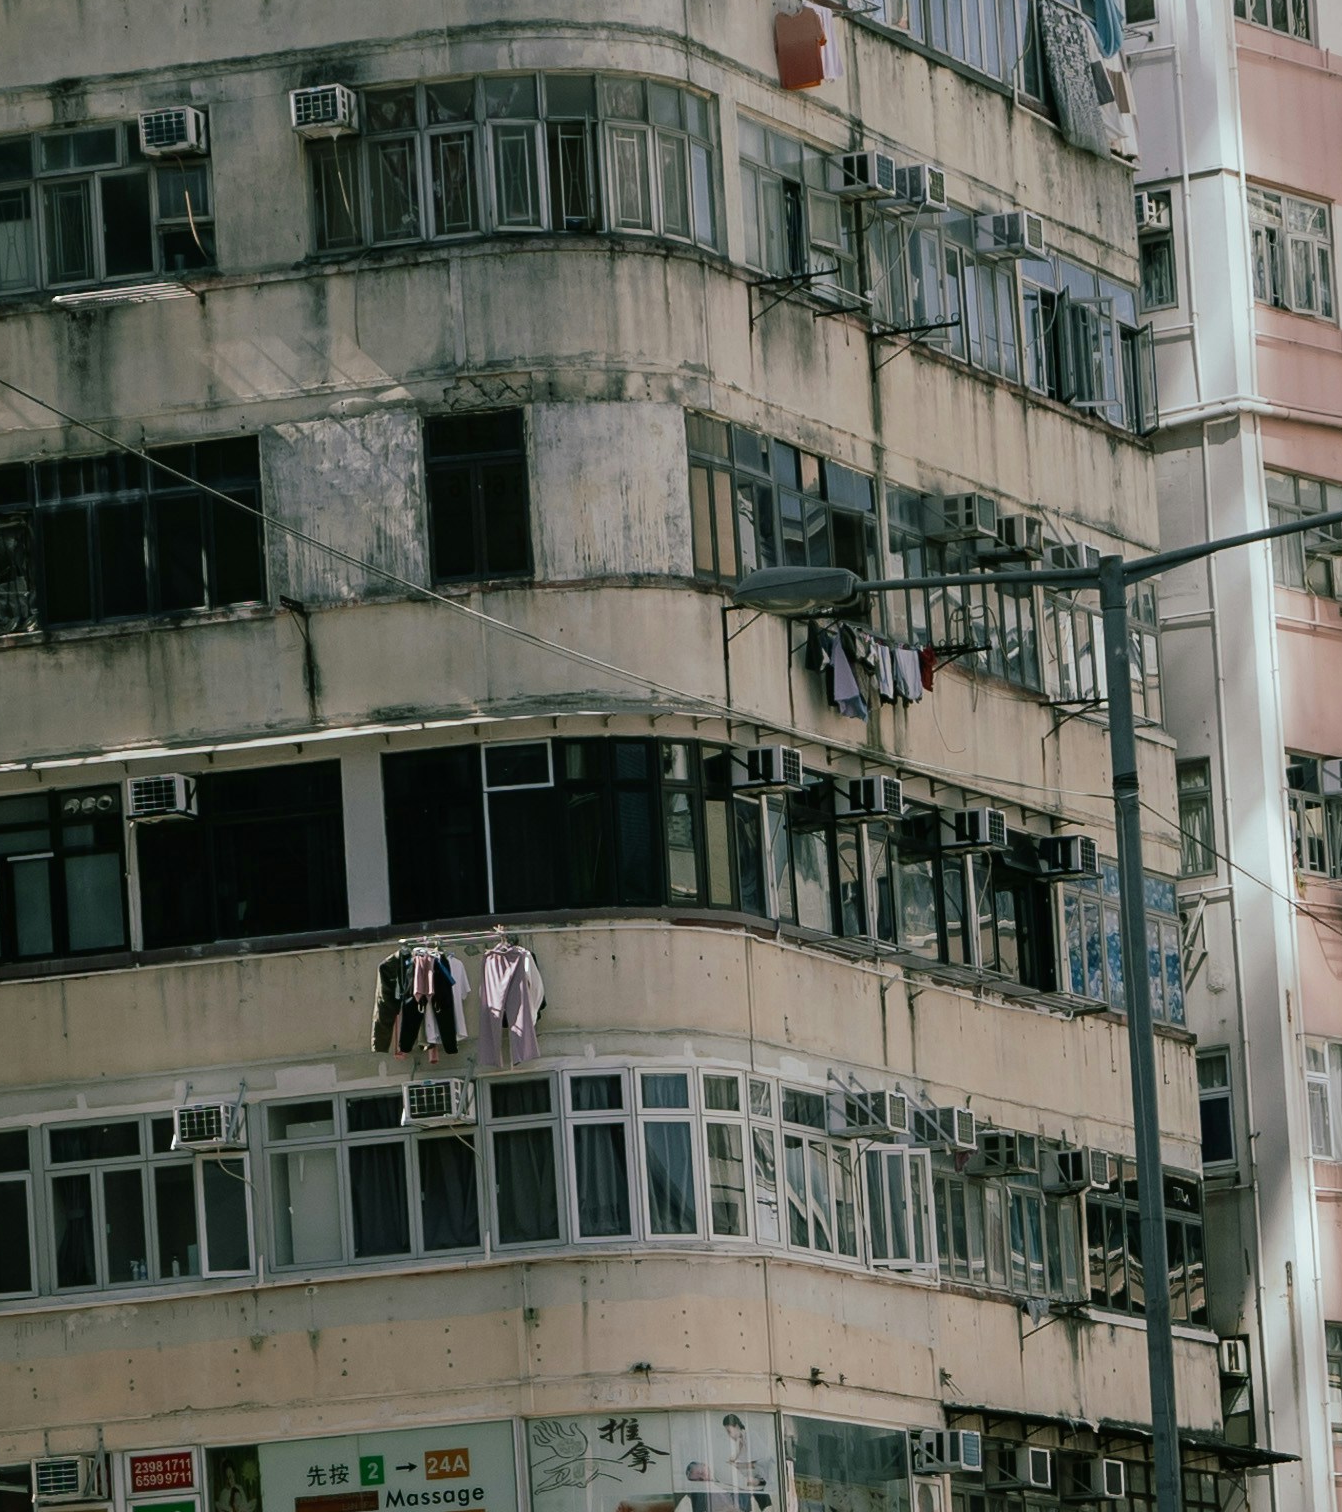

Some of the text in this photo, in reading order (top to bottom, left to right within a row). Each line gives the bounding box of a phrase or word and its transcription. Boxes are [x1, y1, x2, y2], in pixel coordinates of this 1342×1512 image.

[306, 1454, 469, 1487] 先按 2 24A
[385, 1486, 485, 1508] Massage
